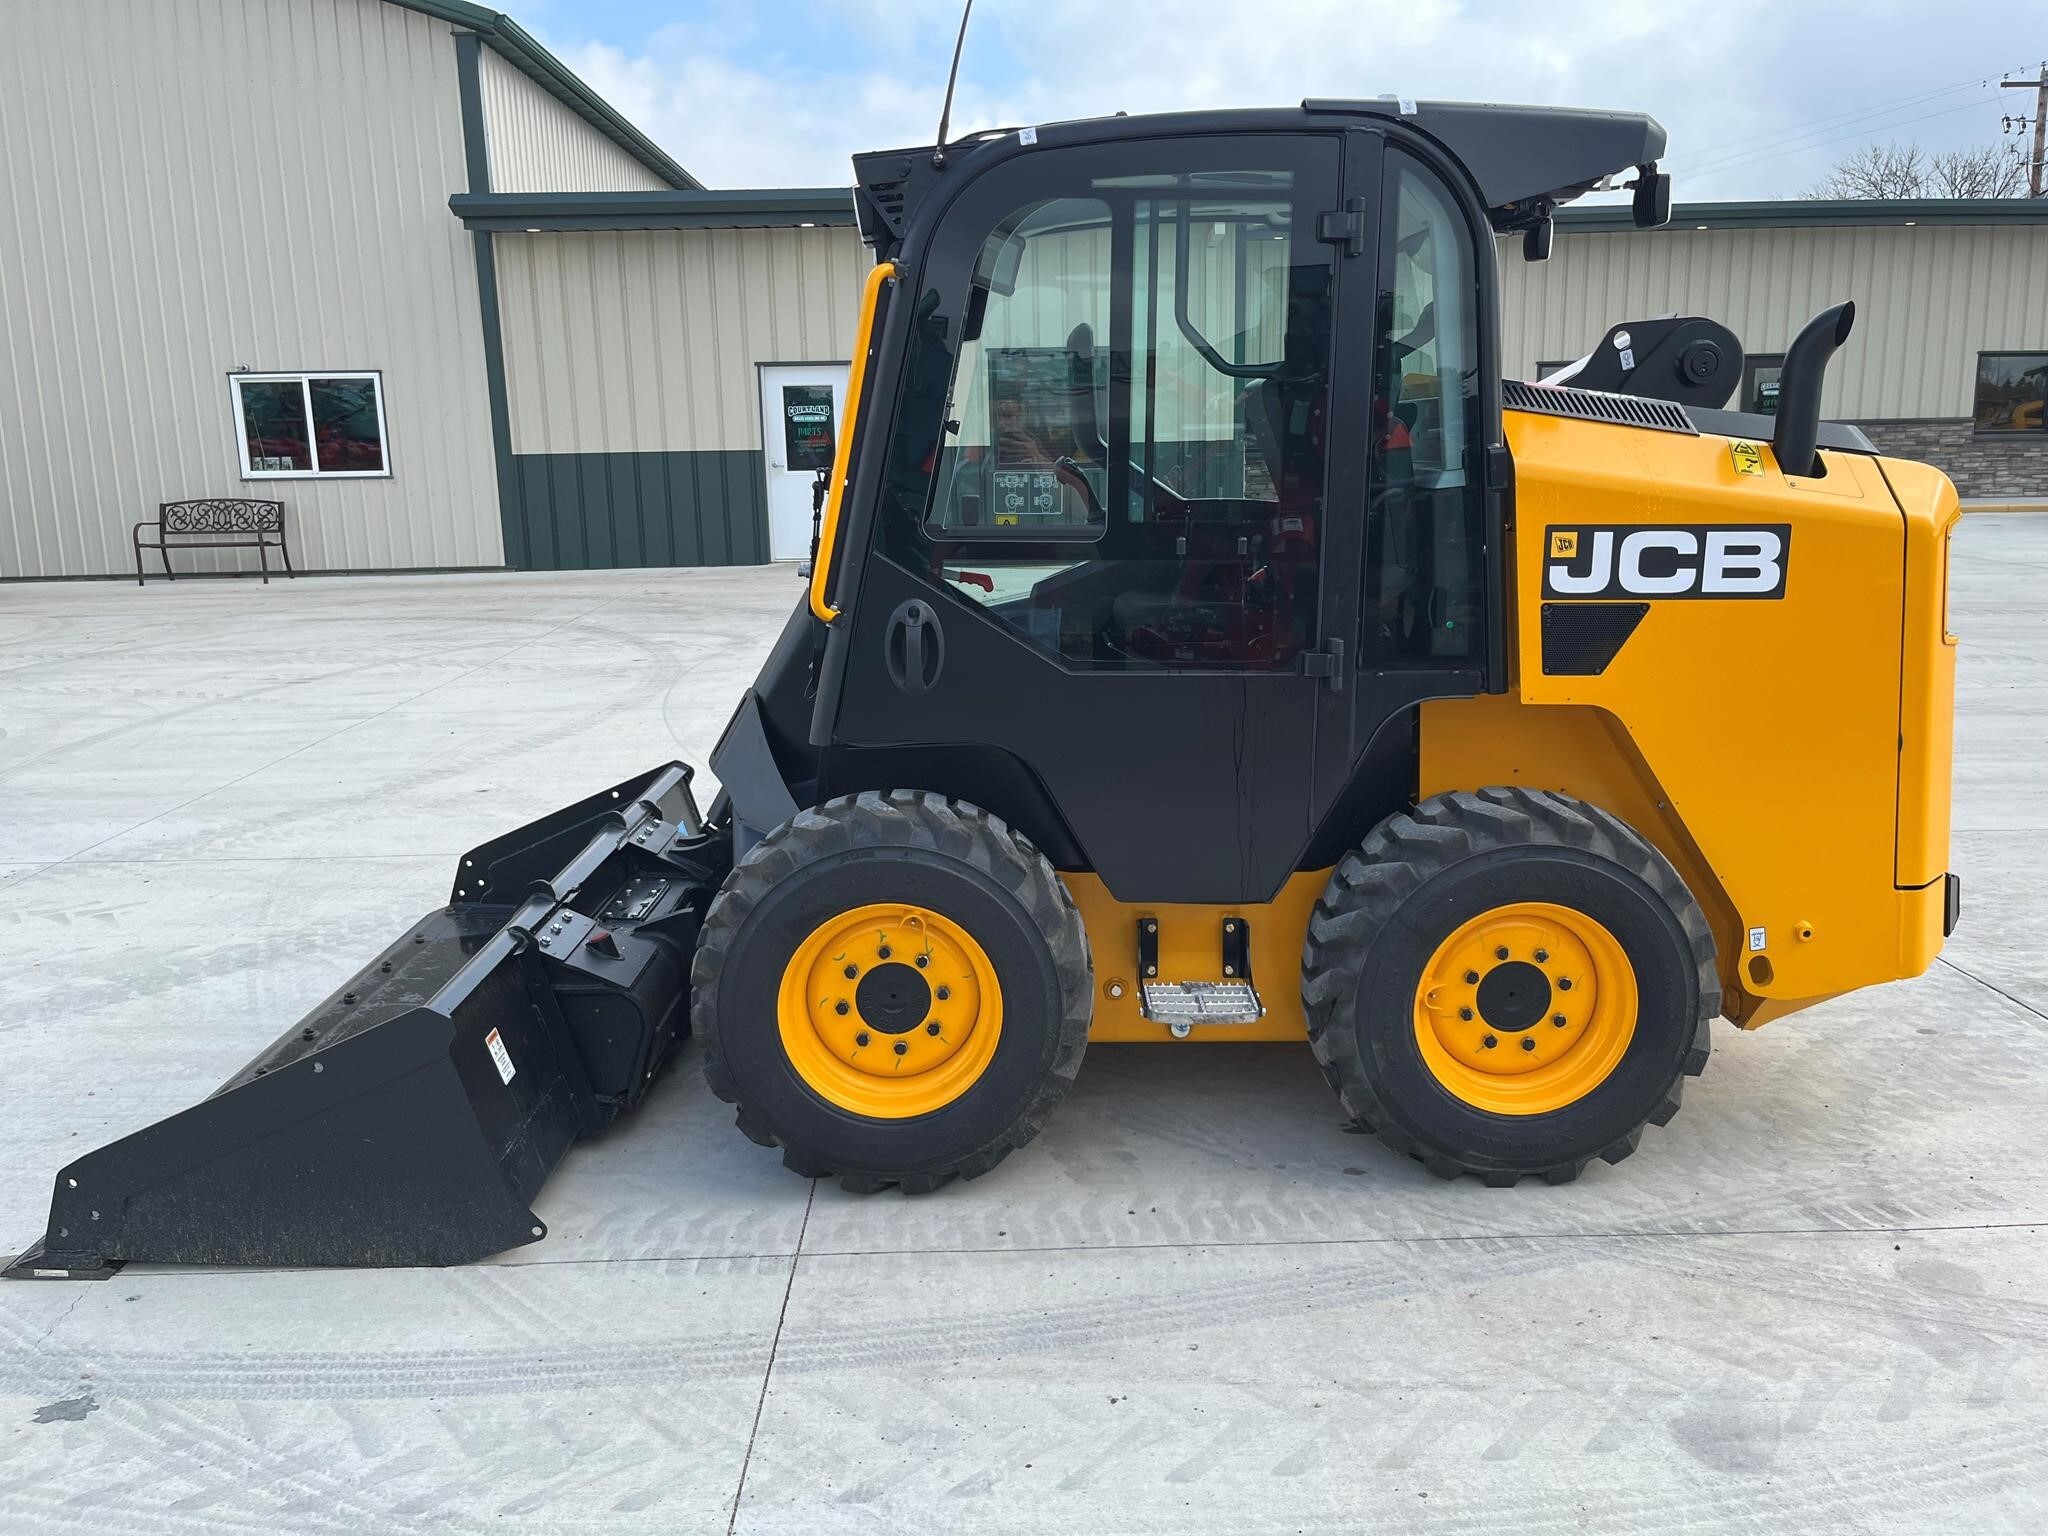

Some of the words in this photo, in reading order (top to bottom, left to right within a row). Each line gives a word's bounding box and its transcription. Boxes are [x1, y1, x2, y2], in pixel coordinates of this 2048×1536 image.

[788, 405, 830, 417] COURTLAND
[798, 427, 822, 437] PARTS
[1556, 537, 1575, 552] JCB
[1549, 531, 1781, 593] JCB
